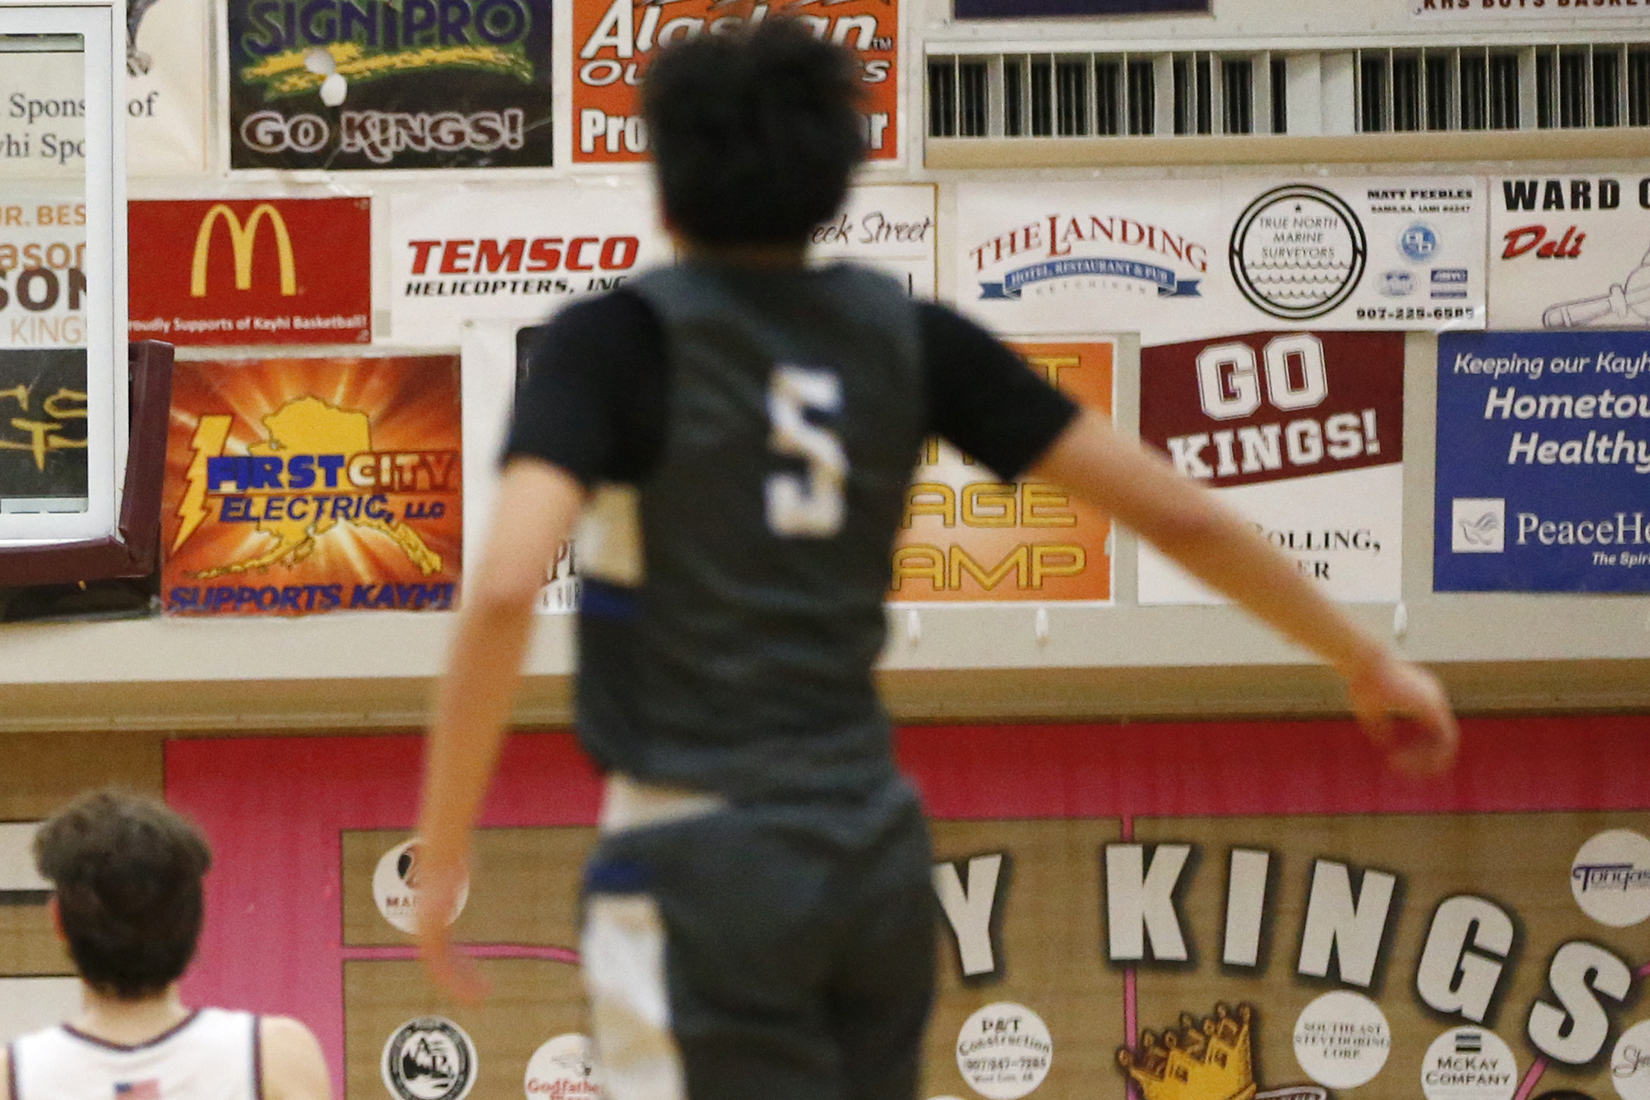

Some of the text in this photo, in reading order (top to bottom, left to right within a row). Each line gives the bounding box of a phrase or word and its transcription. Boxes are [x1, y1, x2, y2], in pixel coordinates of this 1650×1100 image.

[9, 92, 86, 126] Spons
[127, 92, 159, 118] of
[240, 110, 524, 163] GO KINGS!
[1502, 179, 1621, 211] WARD
[408, 237, 639, 275] TEMSCO
[1502, 225, 1586, 260] Deli
[406, 279, 574, 297] HELICOPTERS,
[10, 317, 87, 344] KING
[128, 317, 171, 333] roudly
[1196, 333, 1329, 421] GO
[1454, 353, 1544, 379] Keeping
[1549, 357, 1590, 374] our
[765, 364, 850, 539] 5
[1167, 408, 1381, 479] KINGS!
[1508, 431, 1650, 473] Healthy
[207, 454, 345, 492] FIRST
[219, 495, 445, 524] ELECTRIC, LLC
[1592, 552, 1617, 566] The
[169, 586, 341, 611] SUPPORTS
[1105, 842, 1633, 1065] KINGS
